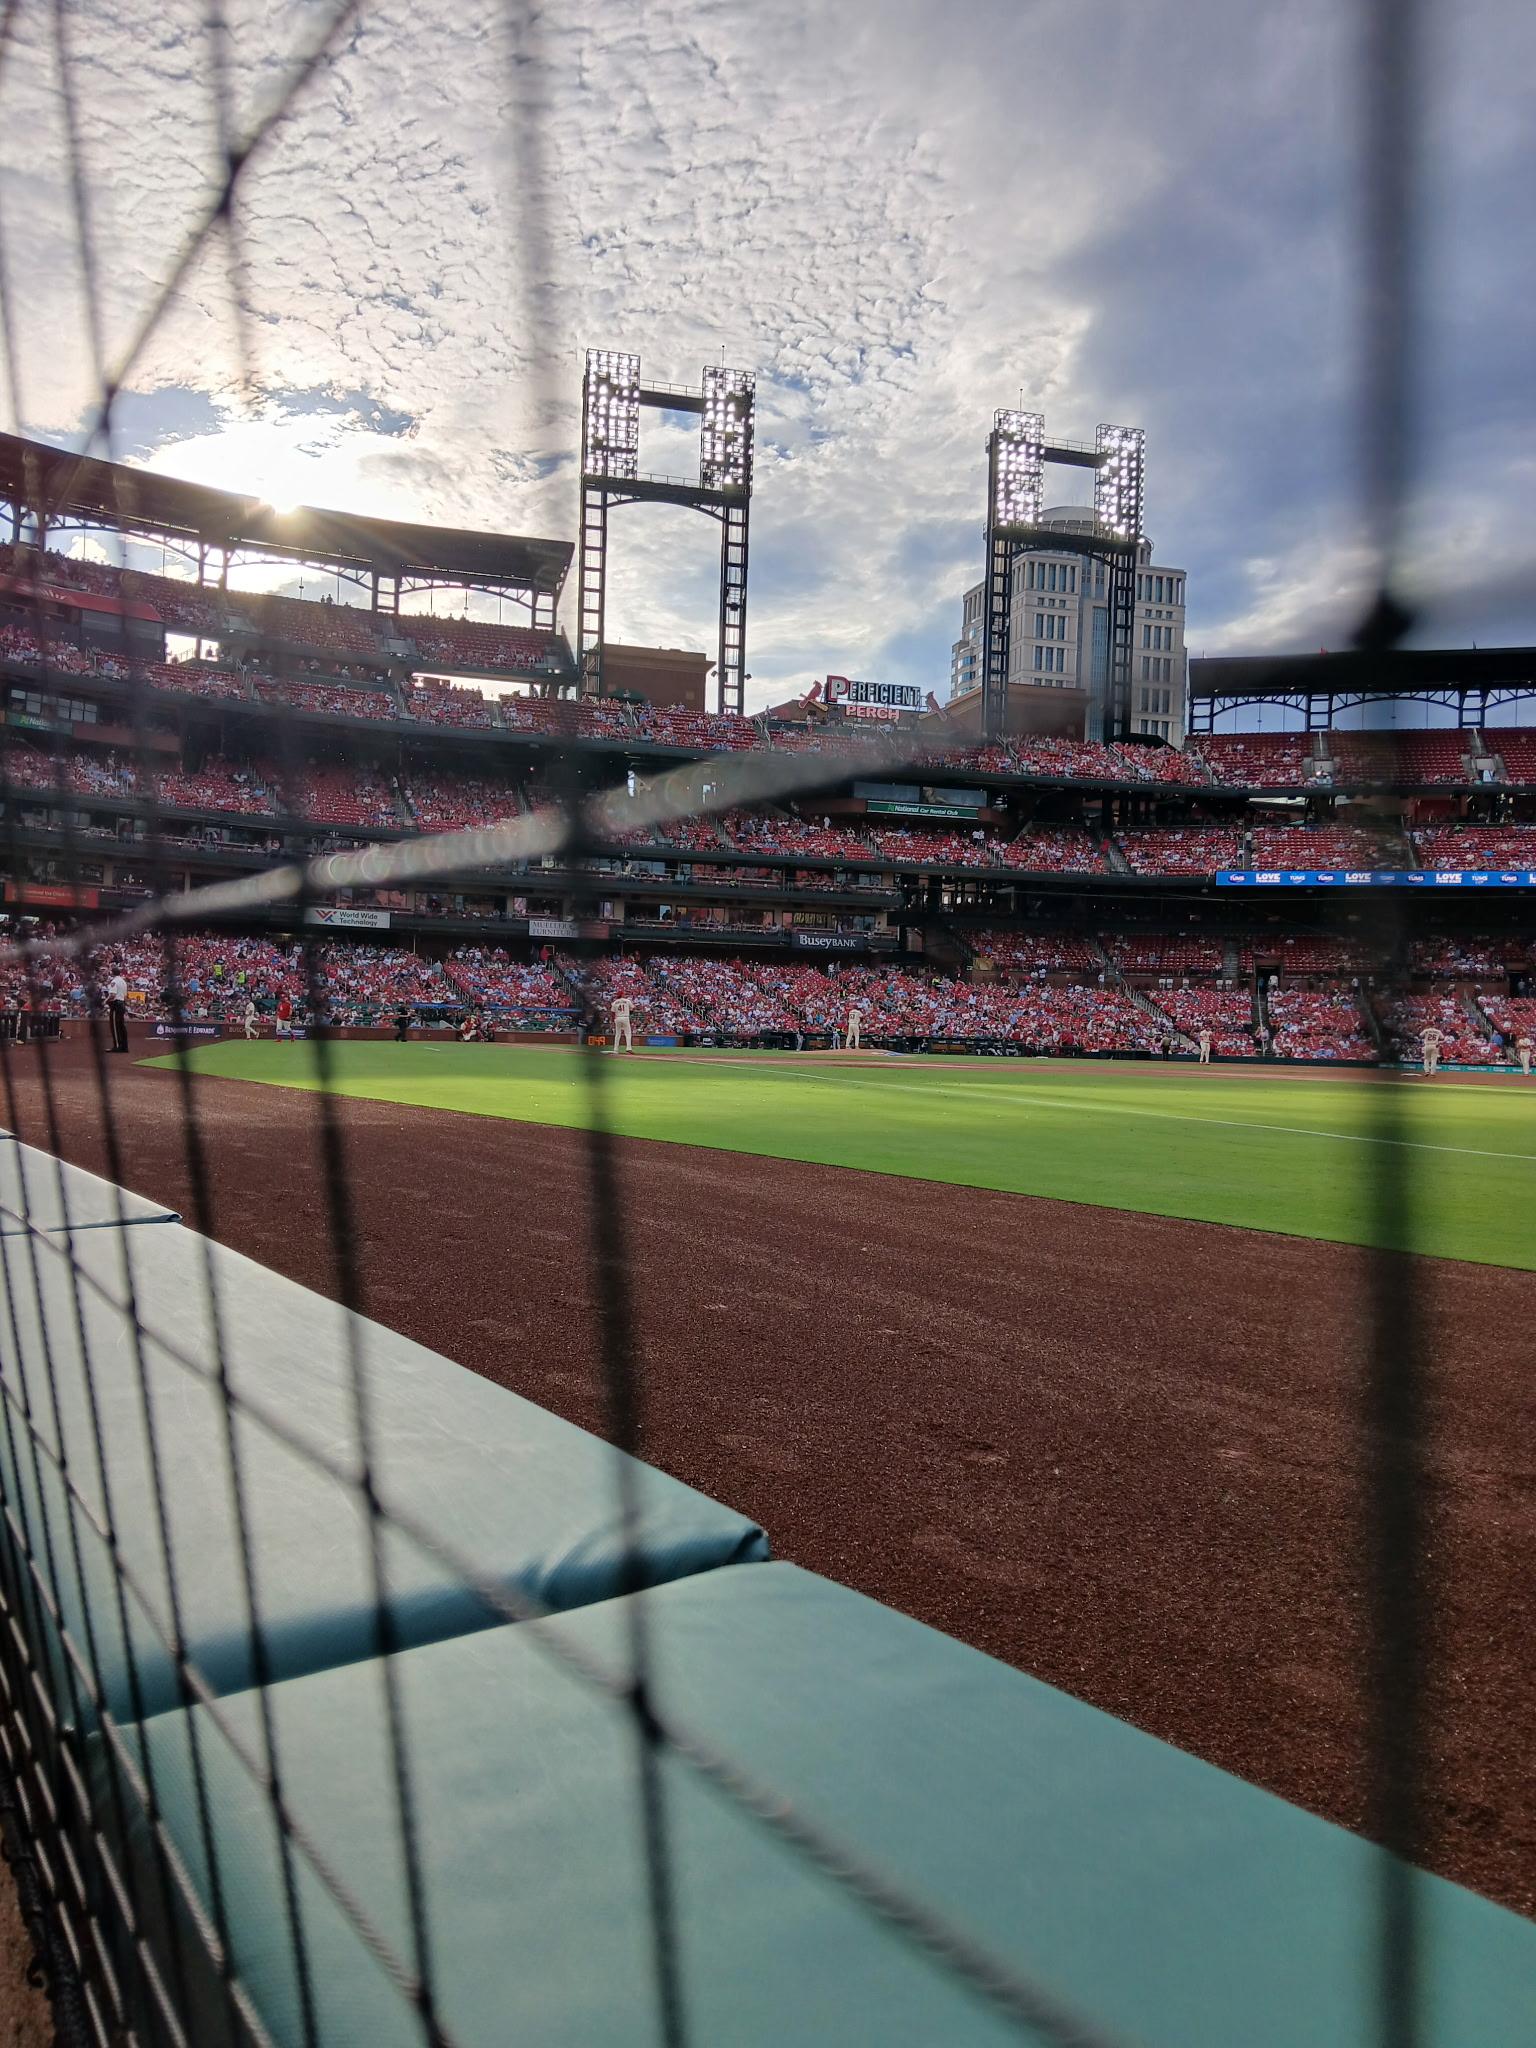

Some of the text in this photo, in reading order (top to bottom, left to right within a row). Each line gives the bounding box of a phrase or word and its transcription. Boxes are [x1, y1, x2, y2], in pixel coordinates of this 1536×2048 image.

[827, 675, 921, 706] PERFICIENT
[845, 705, 900, 720] PERCH
[895, 805, 919, 813] National
[339, 911, 378, 920] World Wide
[339, 918, 378, 927] Technology
[618, 1004, 625, 1012] 41
[165, 1025, 188, 1034] BENJN
